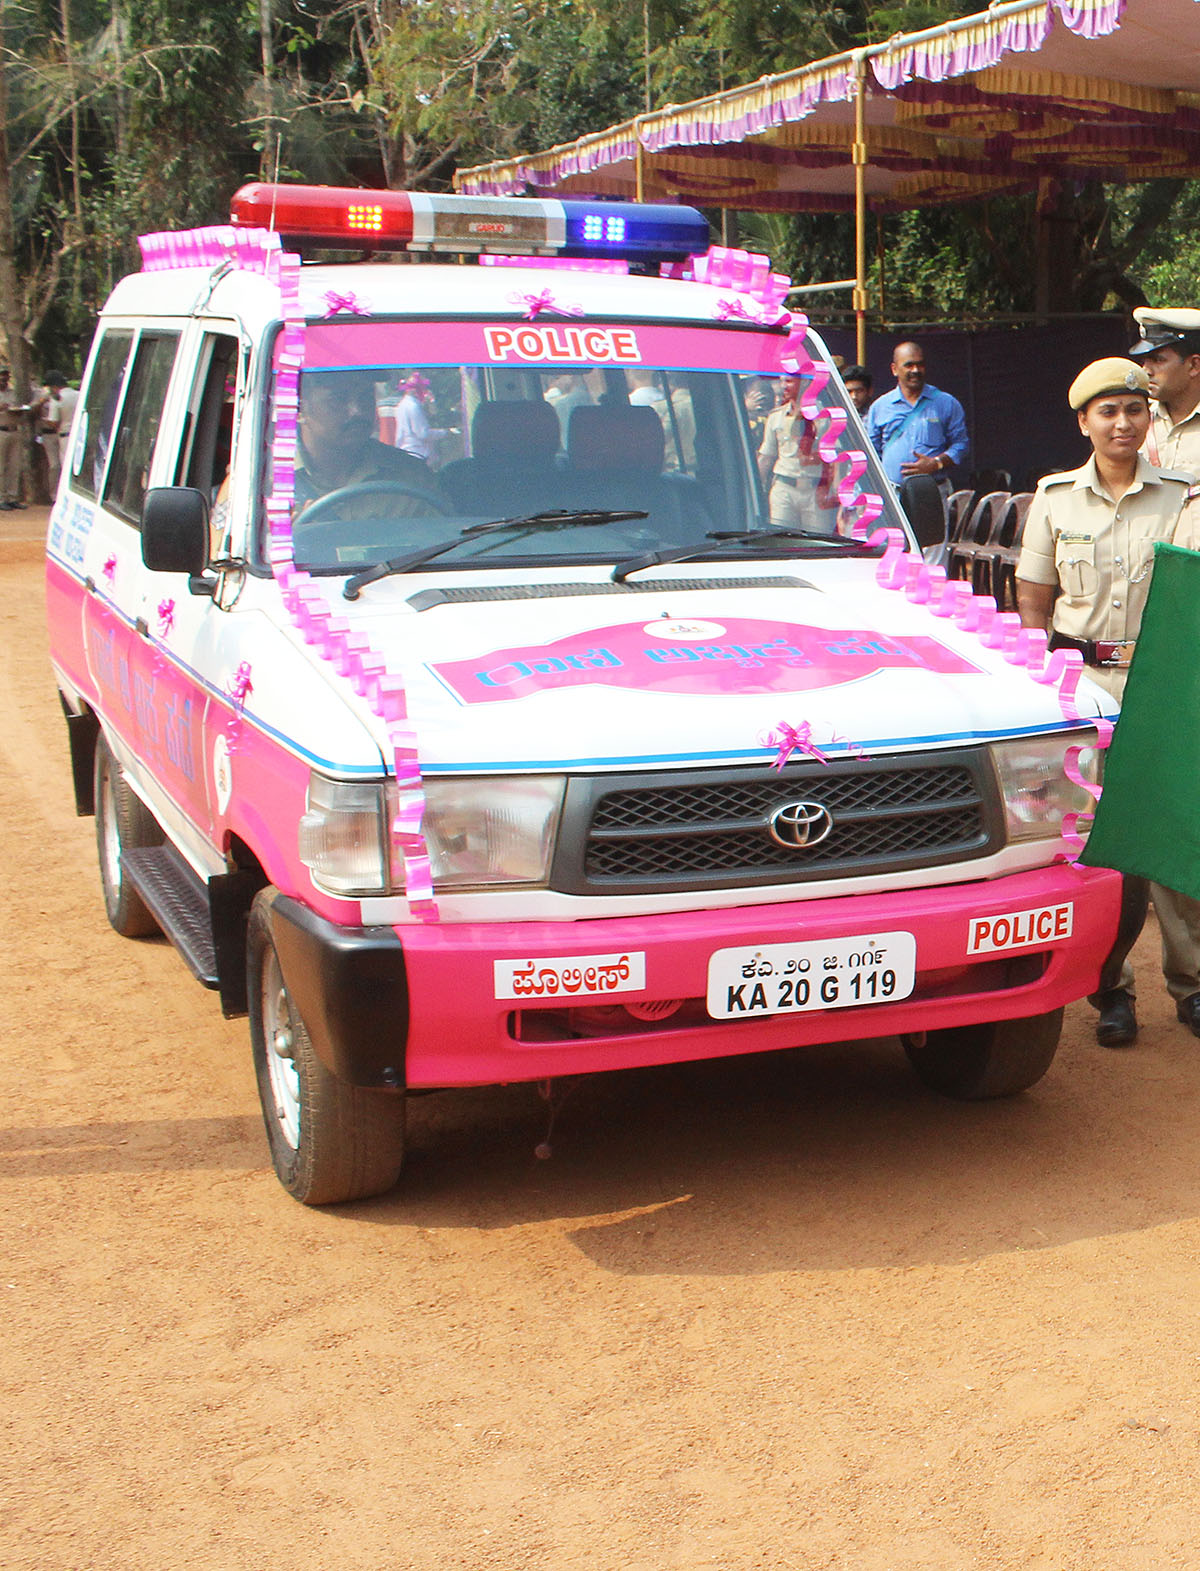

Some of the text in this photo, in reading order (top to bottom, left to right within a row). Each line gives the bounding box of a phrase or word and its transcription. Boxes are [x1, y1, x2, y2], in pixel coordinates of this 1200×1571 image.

[486, 328, 640, 361] POLICE
[973, 907, 1069, 950] POLICE
[512, 955, 630, 995] ಪೊಲೀಸ್
[727, 969, 896, 1012] KA 20 G 119
